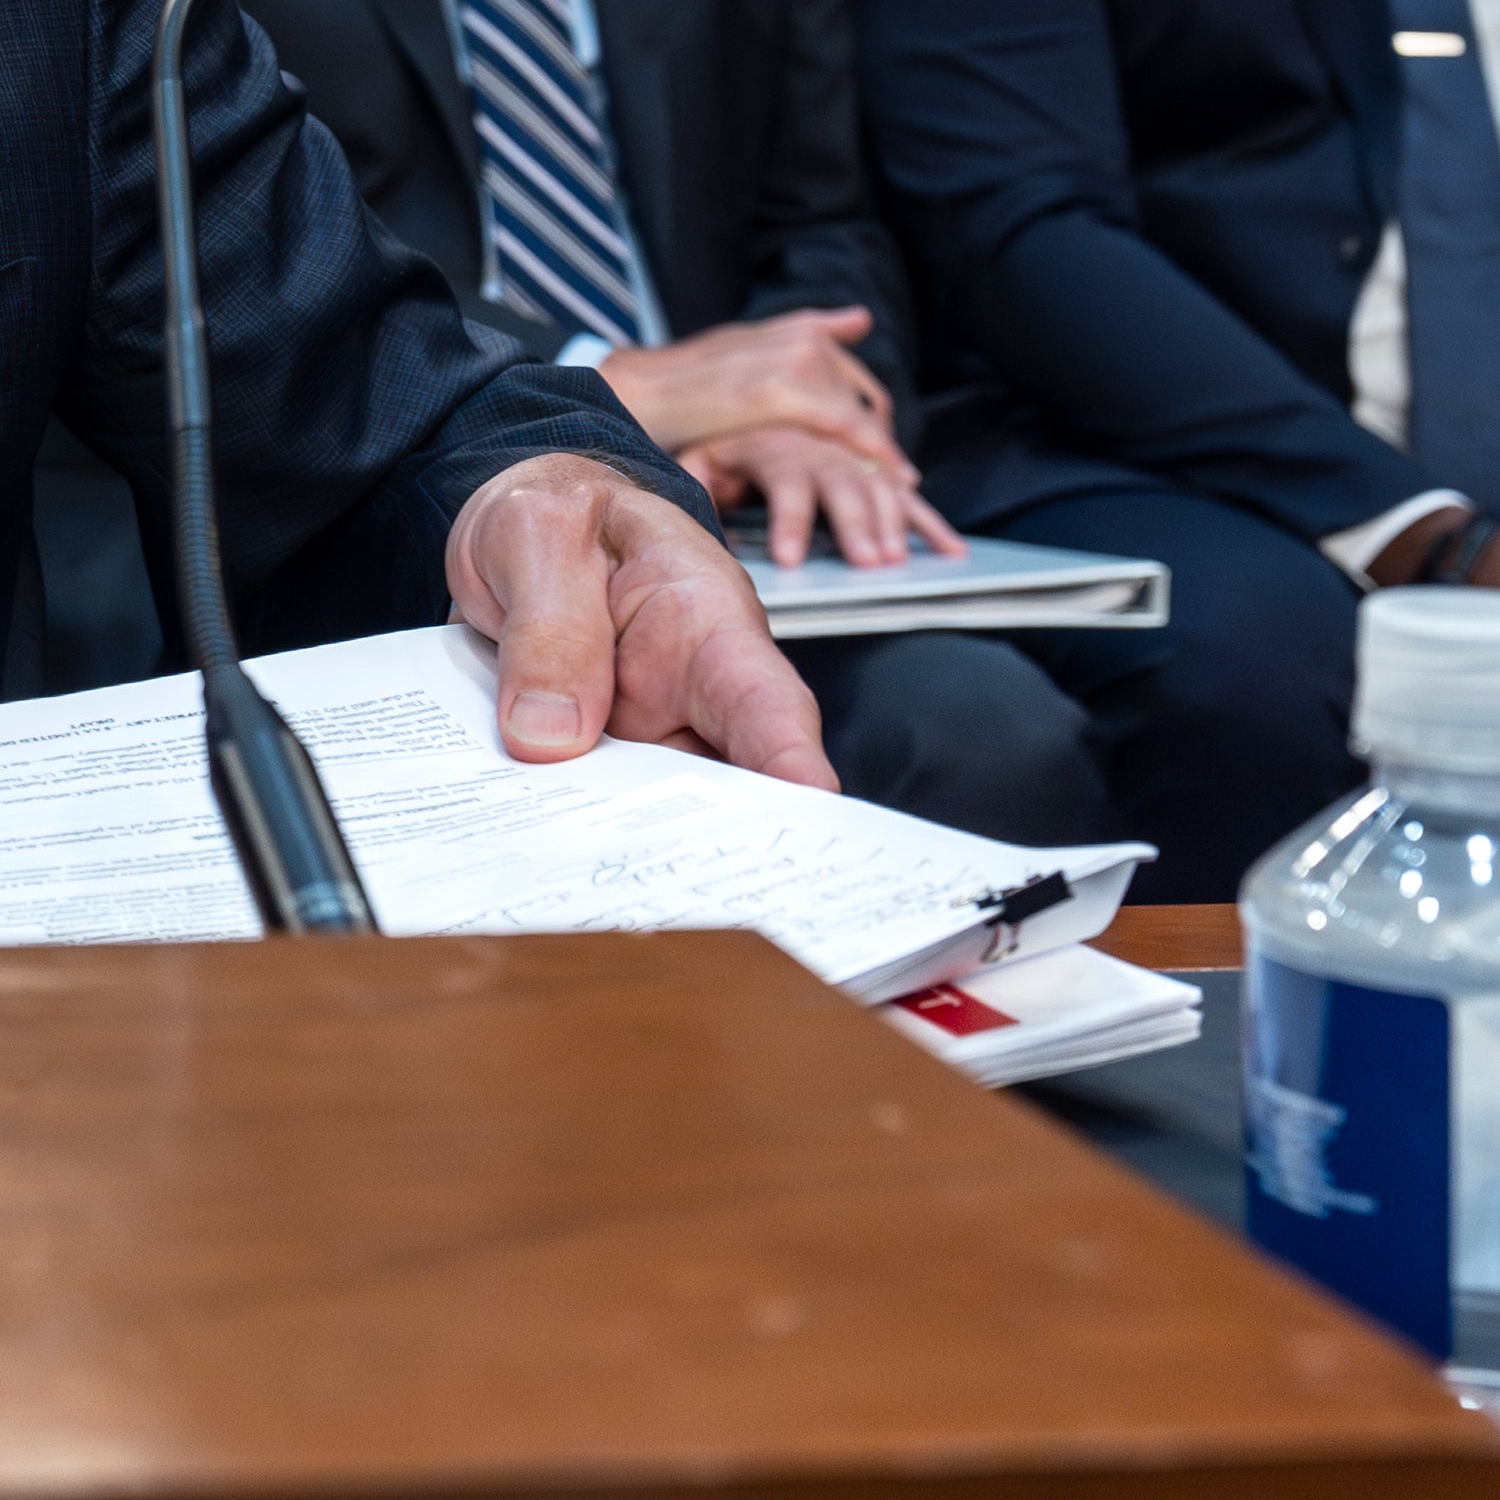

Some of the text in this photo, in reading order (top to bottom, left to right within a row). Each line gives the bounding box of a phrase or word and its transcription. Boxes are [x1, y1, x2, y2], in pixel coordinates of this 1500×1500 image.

[381, 694, 402, 703] due
[350, 700, 378, 710] until
[397, 700, 425, 708] This
[70, 718, 114, 729] DRAFT
[415, 723, 451, 733] These
[19, 731, 80, 743] LIMITED
[321, 729, 362, 737] Expert
[369, 731, 413, 740] experts
[78, 743, 147, 756] preliminary
[166, 745, 187, 753] and
[117, 765, 165, 774] through
[51, 773, 98, 784] Special
[75, 784, 130, 796] Aircraft
